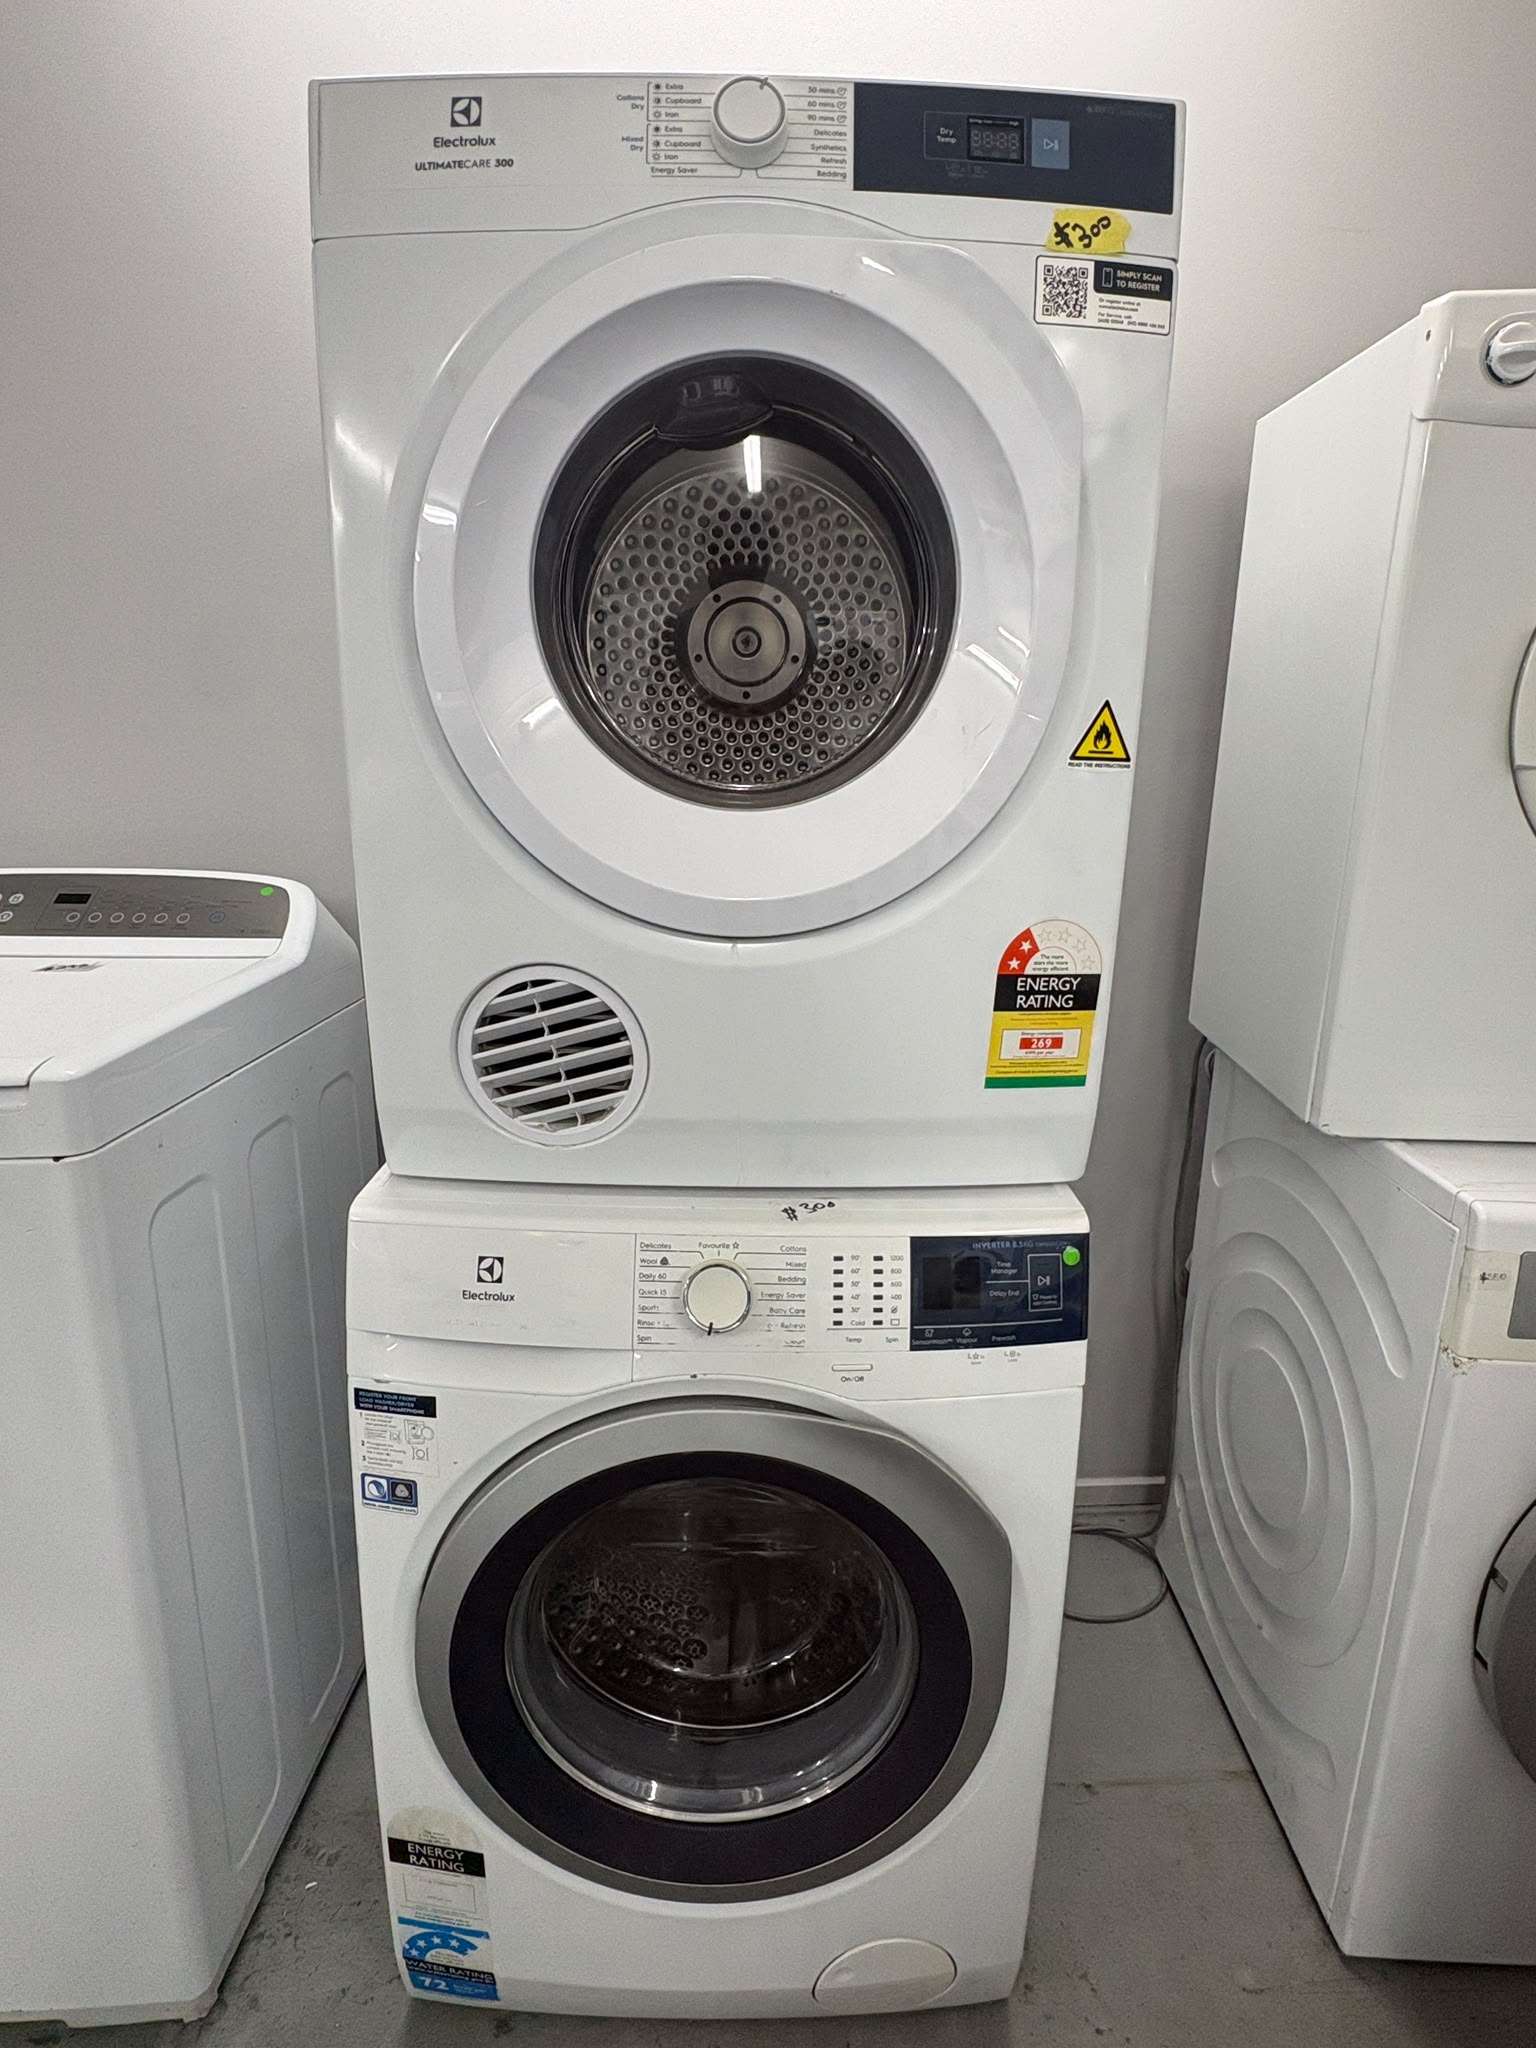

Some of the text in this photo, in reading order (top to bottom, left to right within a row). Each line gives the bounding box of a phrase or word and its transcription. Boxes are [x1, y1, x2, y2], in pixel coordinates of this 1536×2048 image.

[616, 94, 645, 102] Cottons
[664, 97, 702, 105] Cupboard
[631, 103, 644, 111] Dry
[807, 100, 817, 108] 60
[813, 129, 847, 137] Delicates
[939, 127, 953, 137] Dry
[433, 135, 497, 148] Electrolux
[664, 140, 702, 148] Cupboard
[936, 135, 957, 145] Temp
[810, 143, 847, 152] Synthetics
[415, 158, 514, 171] ULTIMATECARE 300
[821, 156, 847, 165] Refresh
[650, 166, 698, 175] Energy Saver
[817, 170, 847, 180] Bedding
[1116, 270, 1163, 282] SIMPLY SCAN
[1115, 280, 1161, 292] TO REGISTER
[1016, 976, 1081, 991] ENERGY
[1015, 994, 1074, 1009] RATING
[1030, 1038, 1053, 1049] 269
[698, 1241, 731, 1250] Favourite
[780, 1245, 807, 1253] Cottons
[972, 1241, 1011, 1249] INVERTER
[890, 1267, 903, 1275] 800
[639, 1272, 656, 1281] Daily
[777, 1275, 807, 1285] Bedding
[462, 1289, 516, 1302] Electrolux
[638, 1288, 658, 1296] Quick
[660, 1288, 667, 1296] 15
[760, 1291, 784, 1300] Energy
[989, 1289, 1020, 1298] Delay End
[850, 1319, 866, 1327] Cold
[637, 1334, 652, 1342] Spin
[845, 1336, 899, 1344] Temp Spin
[840, 1375, 865, 1383] On/Off
[359, 1391, 383, 1399] REGISTER
[407, 1842, 465, 1861] ENERGY
[409, 1854, 465, 1873] RATING
[406, 1959, 448, 1972] WATER
[449, 1967, 494, 1982] RATING
[418, 1976, 450, 1991] 72
